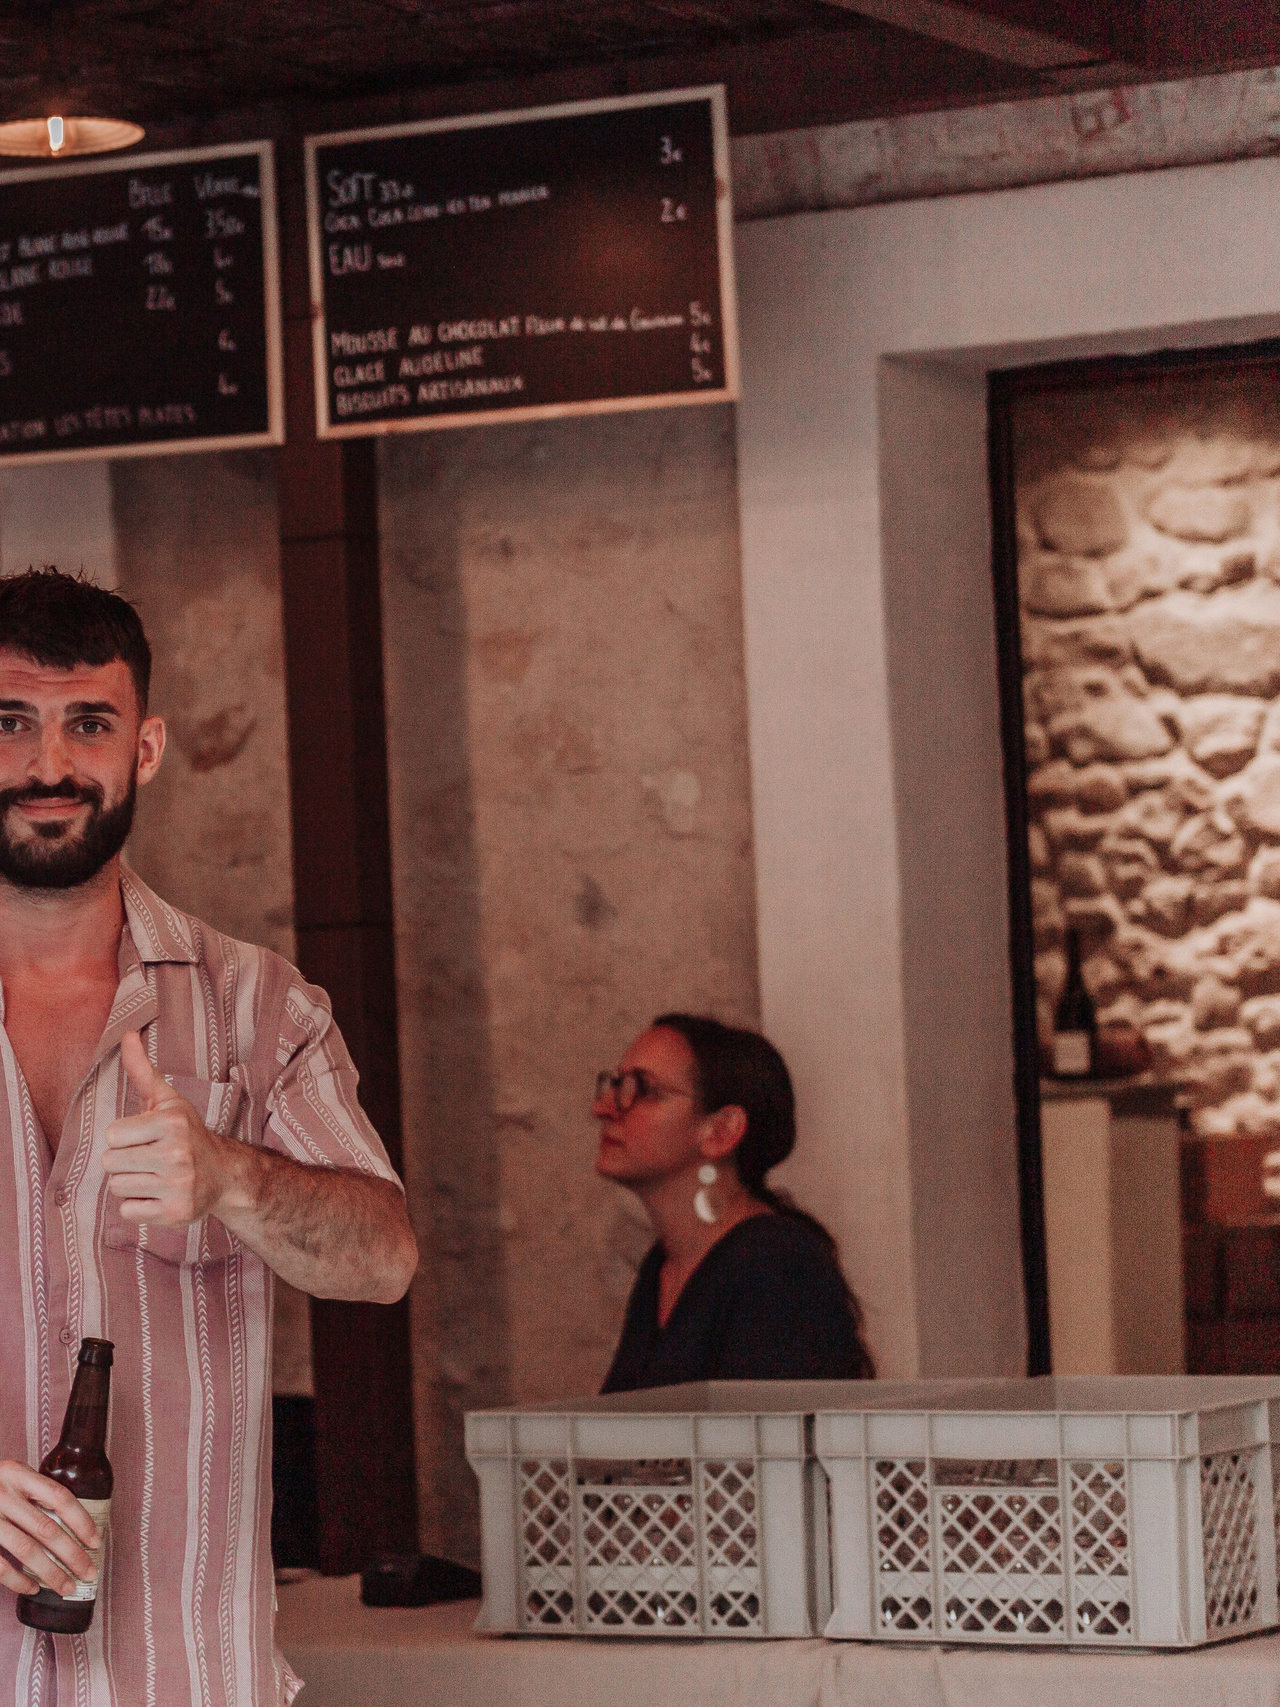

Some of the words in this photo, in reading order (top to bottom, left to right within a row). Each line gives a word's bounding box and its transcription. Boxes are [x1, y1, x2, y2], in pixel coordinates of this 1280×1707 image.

[328, 242, 373, 277] EAU
[331, 325, 399, 358] MOUSSE
[408, 323, 434, 347] AU
[437, 314, 521, 343] CHOCOLAT
[333, 358, 386, 387] GLACE
[336, 382, 412, 416] BISCUITS
[417, 375, 525, 405] ARTISANAUX
